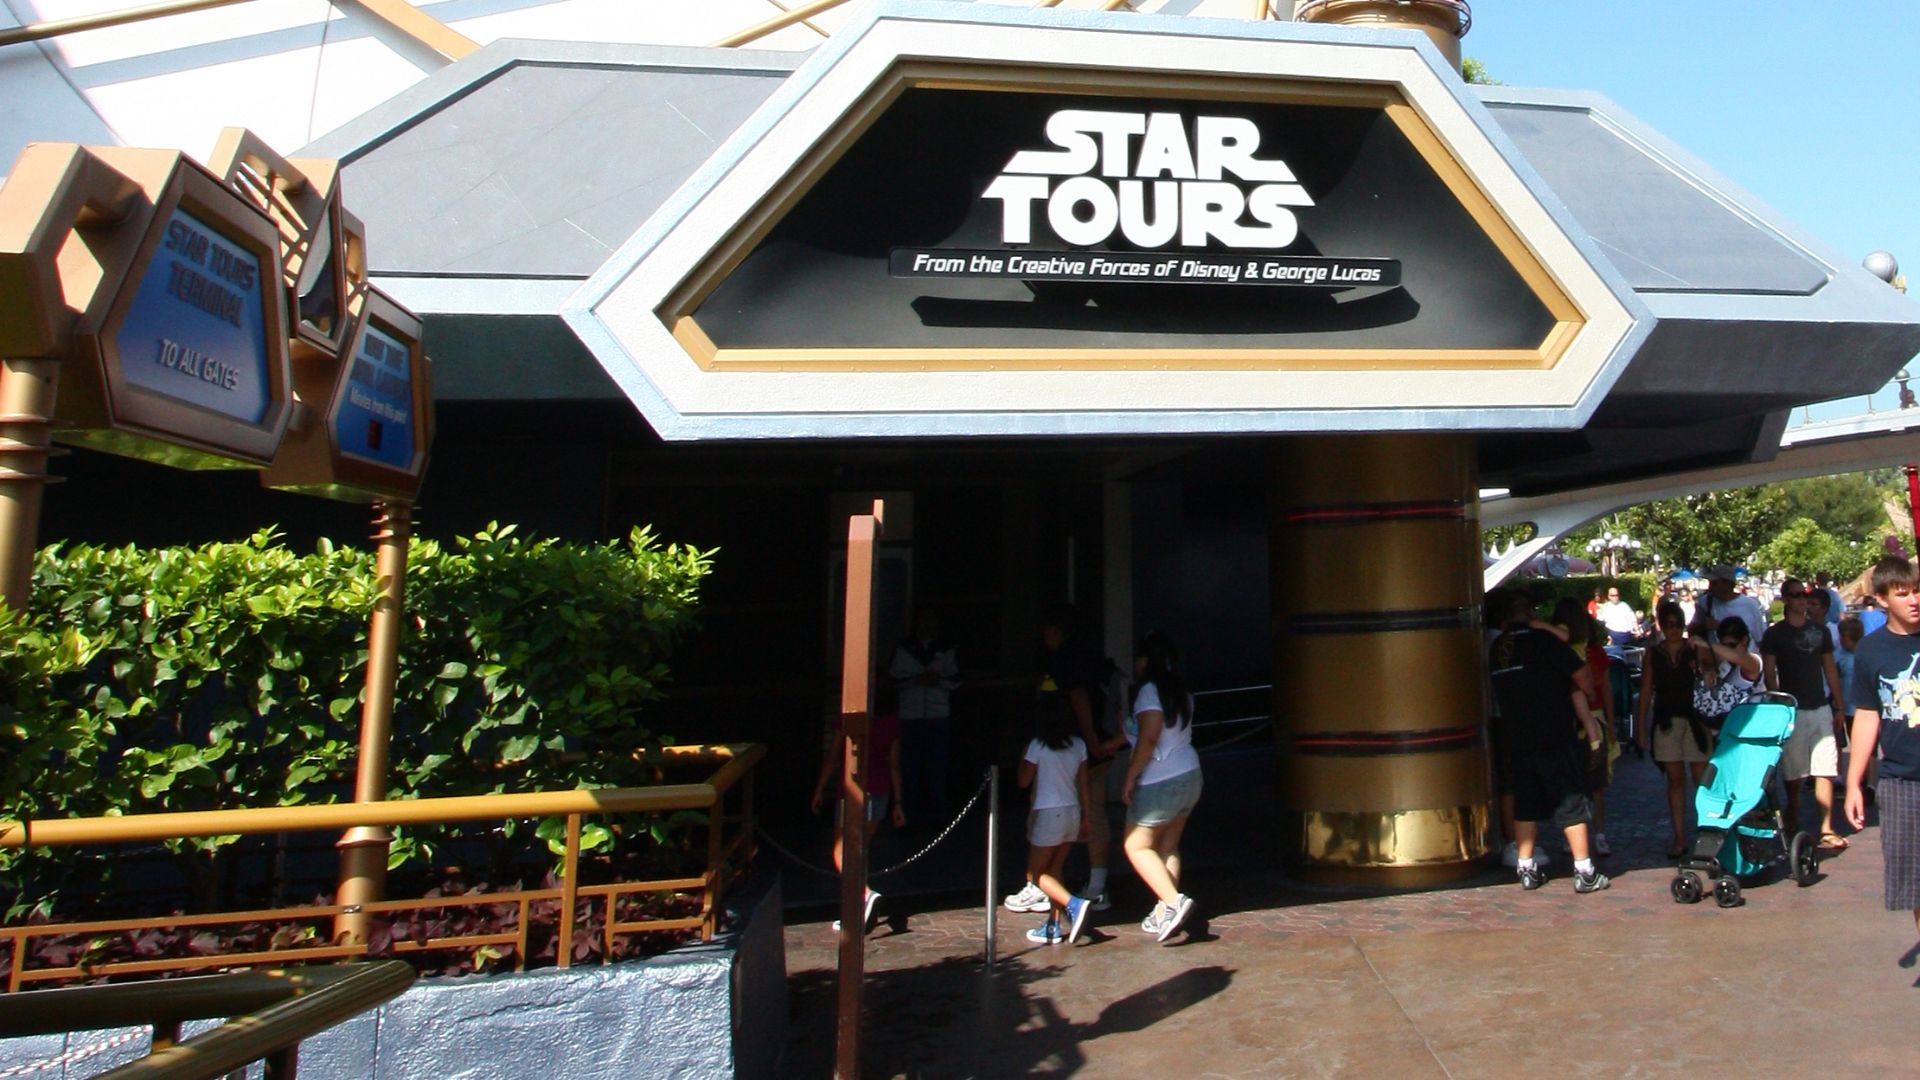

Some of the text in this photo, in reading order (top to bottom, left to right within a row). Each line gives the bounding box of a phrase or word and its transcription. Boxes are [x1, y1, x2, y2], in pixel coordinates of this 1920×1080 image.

[1003, 110, 1297, 182] STAR
[982, 176, 1315, 248] TOURS
[167, 219, 256, 291] STAR TOURS
[913, 254, 966, 273] From
[970, 255, 1002, 273] the
[1007, 256, 1086, 275] Creative
[1089, 258, 1150, 276] Forces
[1180, 260, 1241, 282] Disney
[1244, 262, 1259, 279] &
[1262, 262, 1327, 284] George
[1331, 264, 1382, 281] Lucas
[169, 261, 244, 328] TERMINAL
[160, 339, 240, 390] TO ALL GATES
